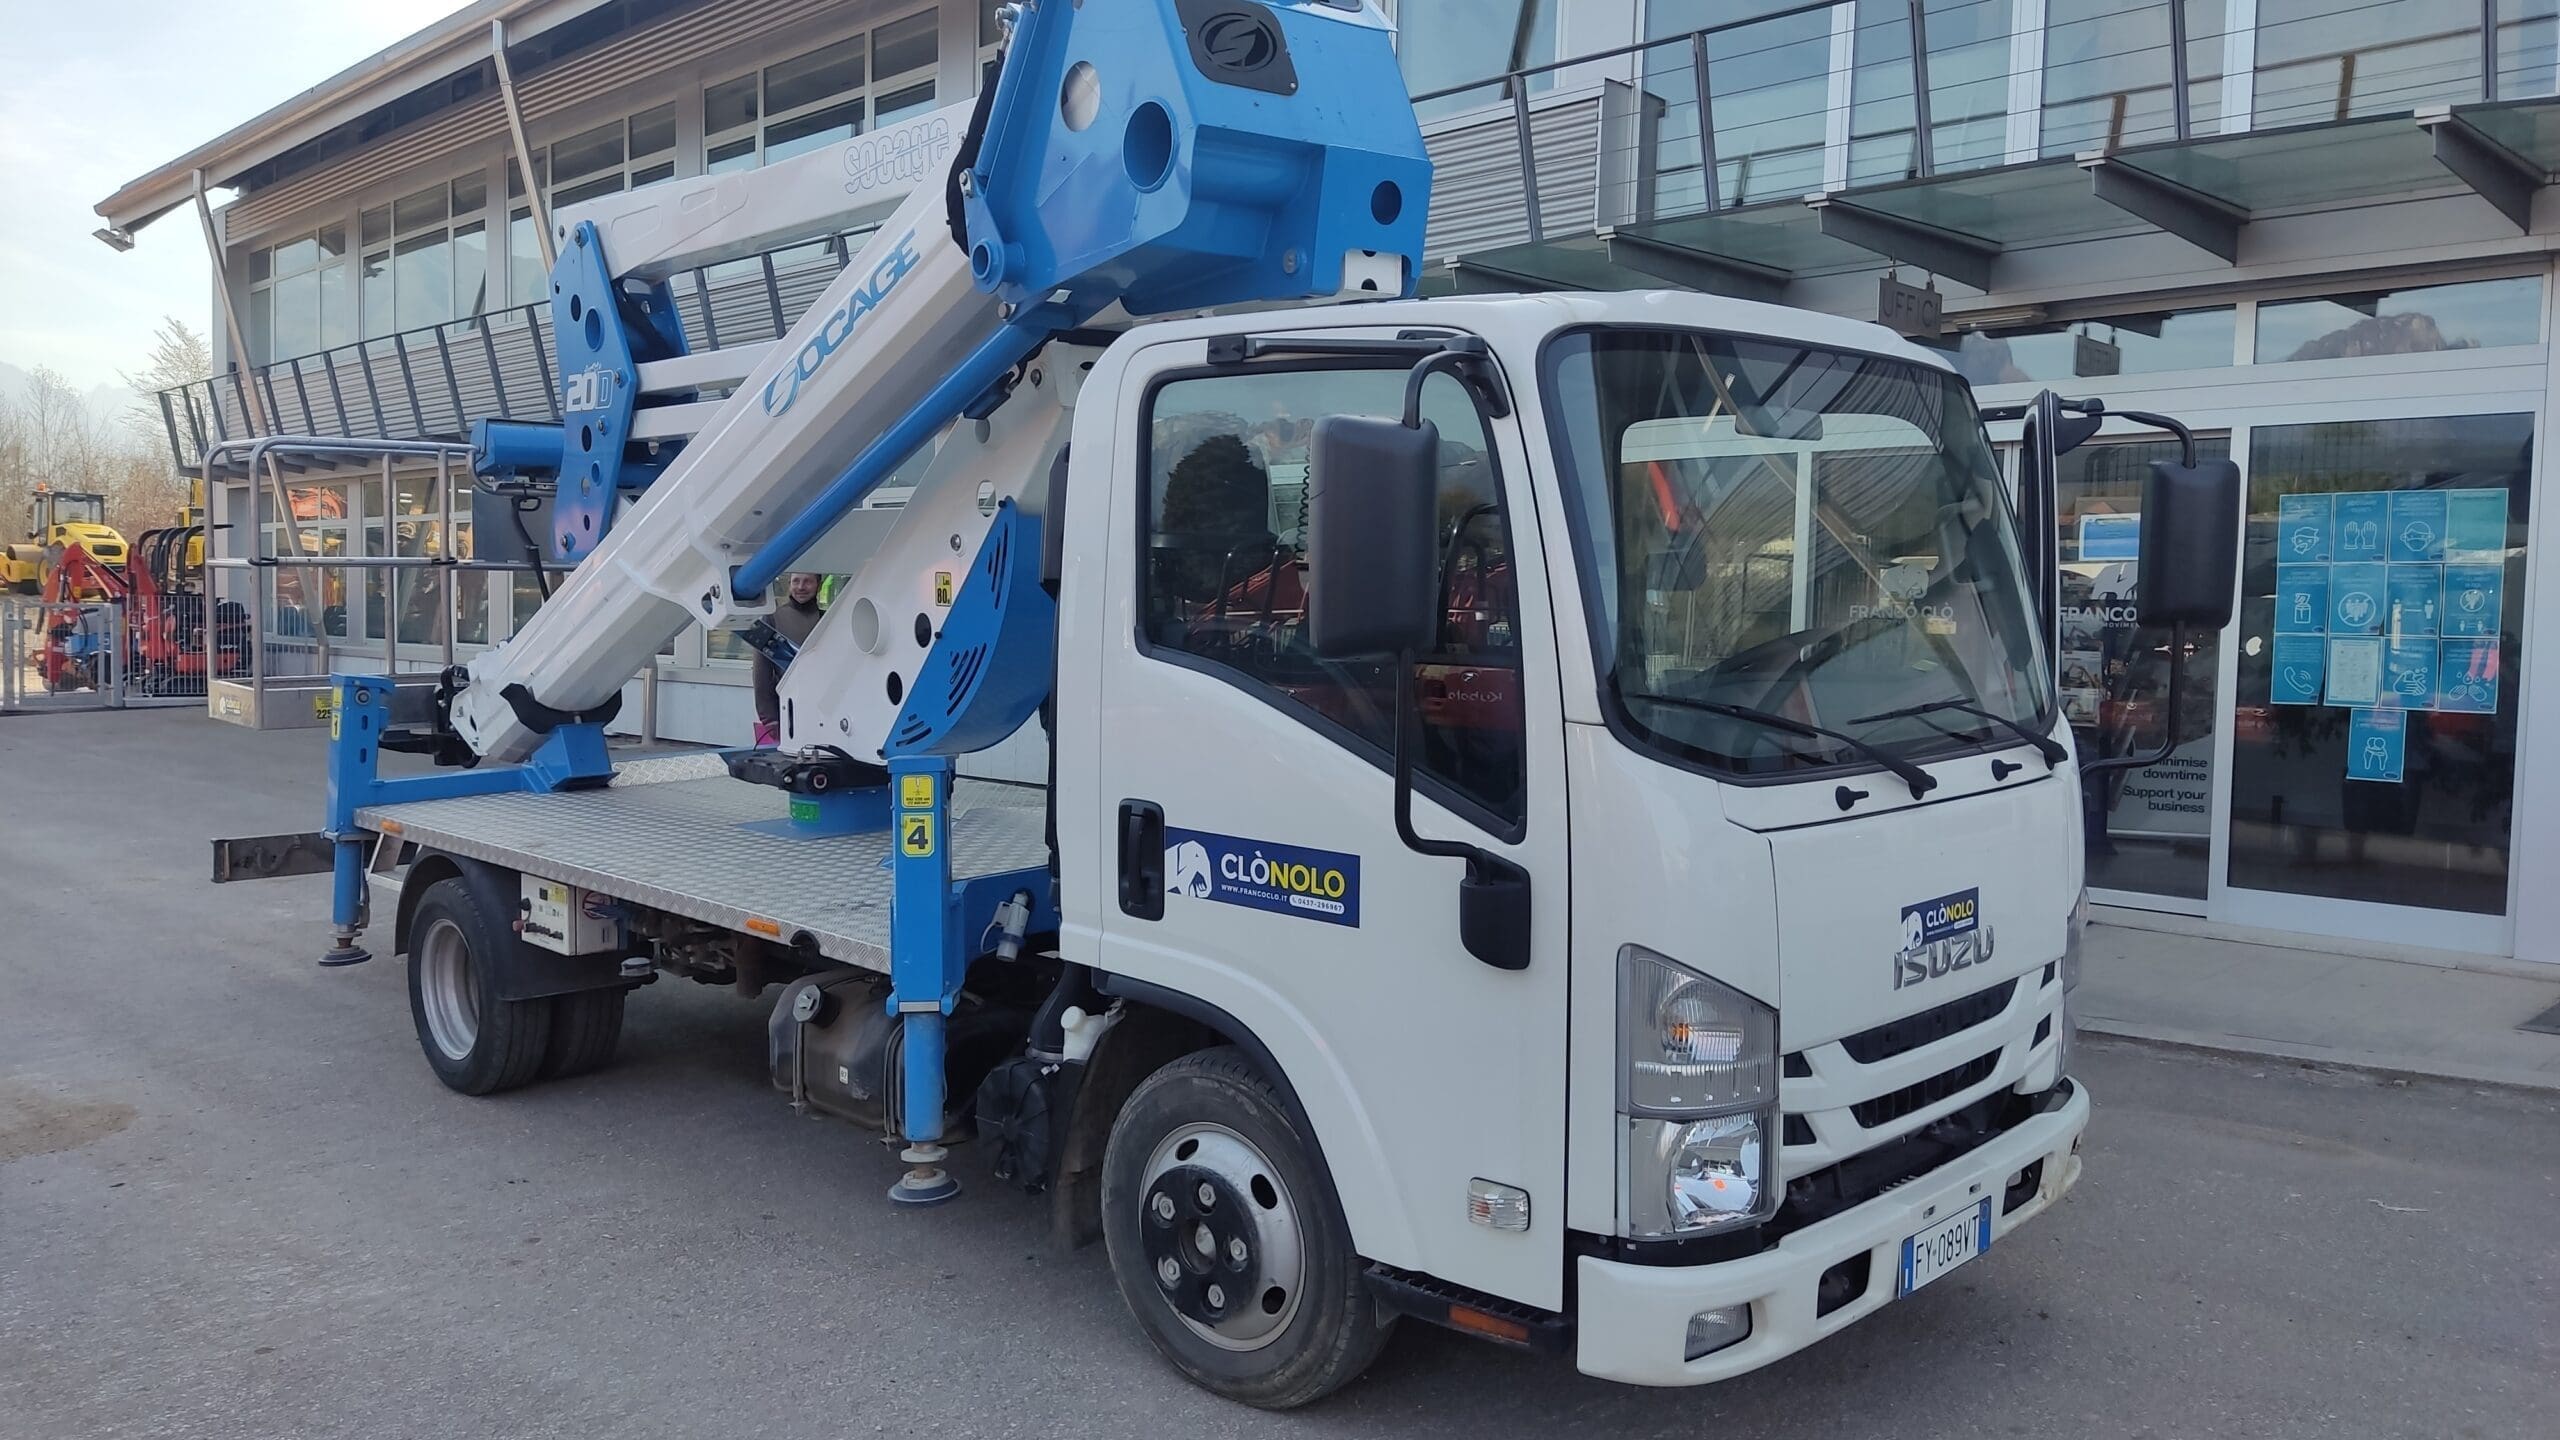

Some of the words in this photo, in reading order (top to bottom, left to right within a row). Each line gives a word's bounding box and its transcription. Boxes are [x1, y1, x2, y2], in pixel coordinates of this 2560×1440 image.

[1882, 288, 1938, 328] UFFICI
[2143, 769, 2207, 781] downtime
[2158, 757, 2208, 768] inimise
[2123, 785, 2174, 799] Support
[2177, 789, 2206, 801] your
[2148, 801, 2205, 813] business
[907, 825, 928, 850] 4
[1220, 850, 1346, 899] CLÒNOLO
[1926, 899, 1974, 928] CLÒNOLO
[1893, 924, 1994, 991] ISUZU
